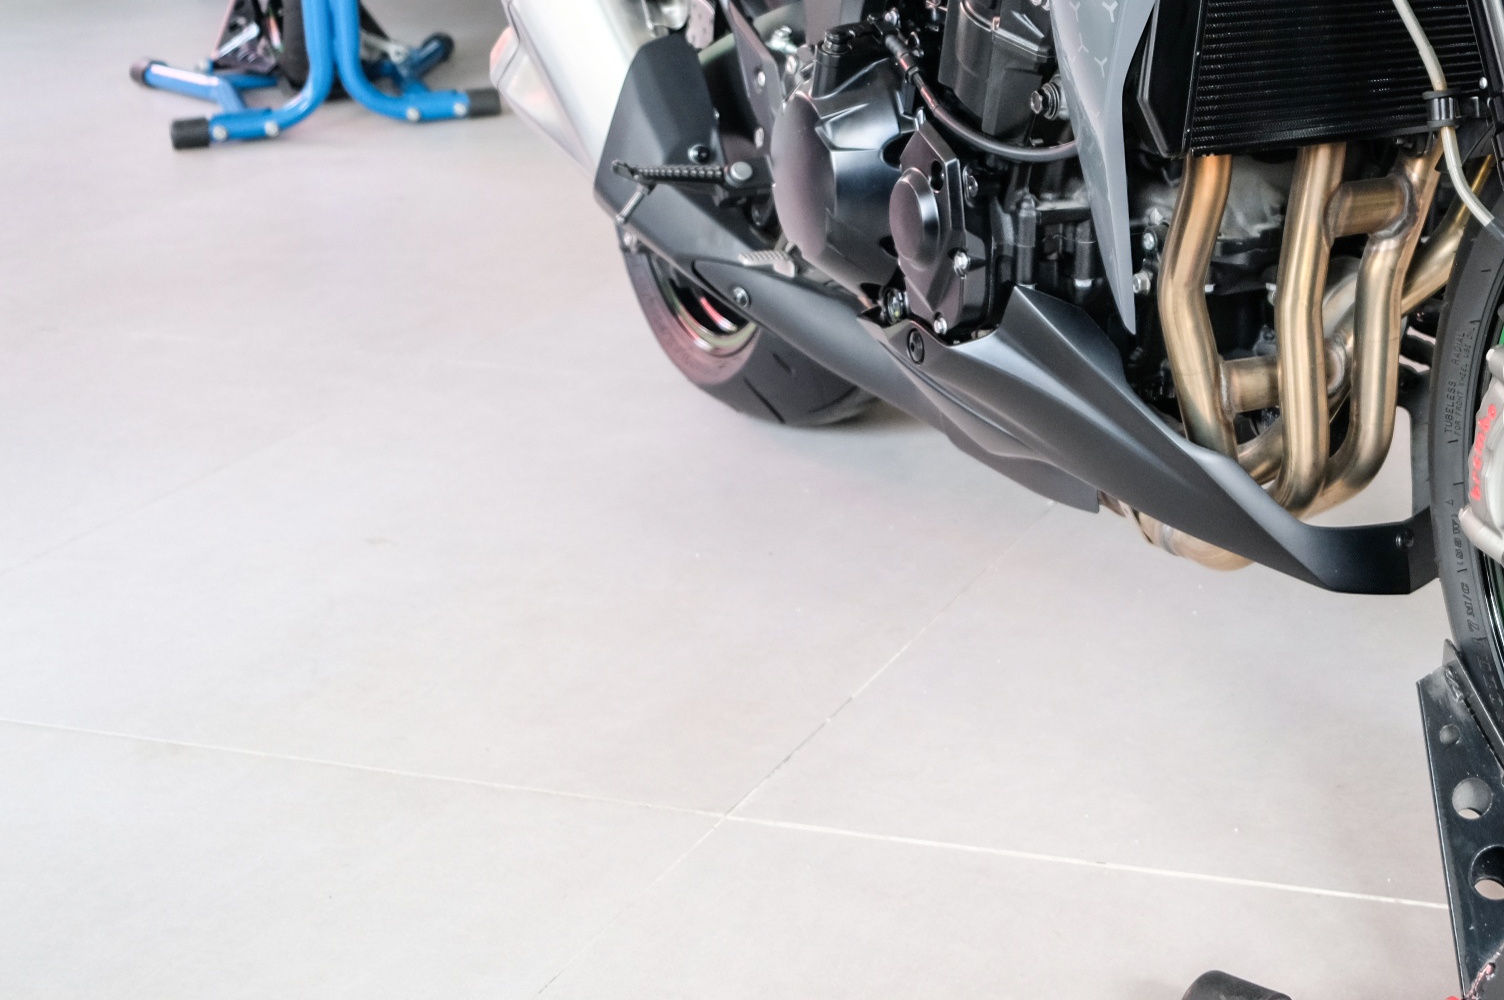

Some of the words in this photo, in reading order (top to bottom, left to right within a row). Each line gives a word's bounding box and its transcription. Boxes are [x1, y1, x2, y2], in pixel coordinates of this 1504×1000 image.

[1444, 380, 1457, 434] TUBELESS
[1451, 333, 1466, 366] RADIAL
[1455, 393, 1464, 421] FRONT
[1470, 404, 1497, 501] brembo
